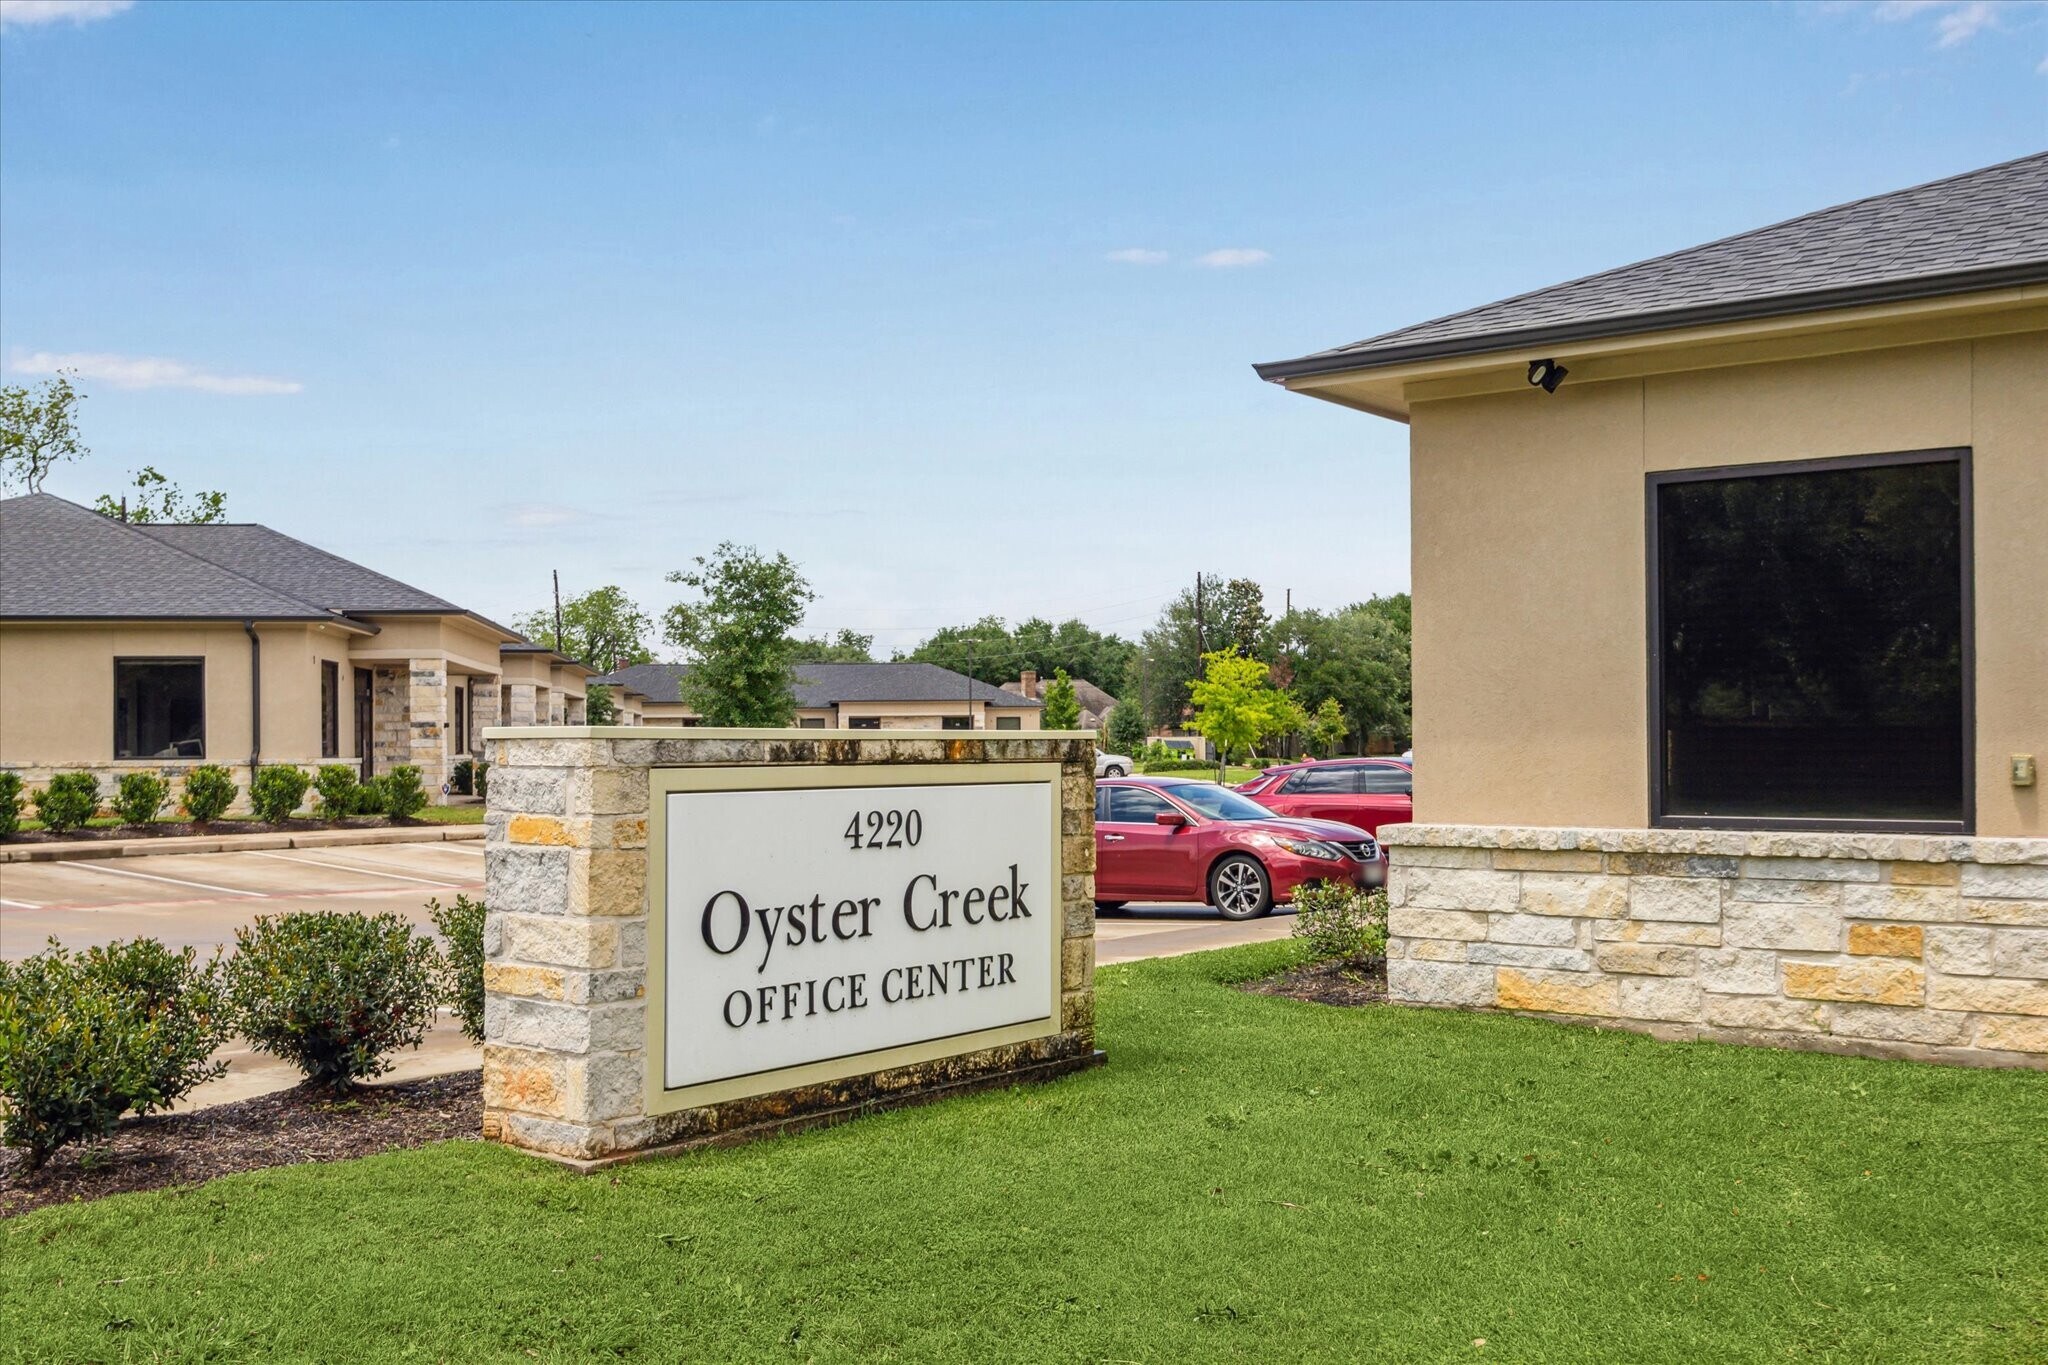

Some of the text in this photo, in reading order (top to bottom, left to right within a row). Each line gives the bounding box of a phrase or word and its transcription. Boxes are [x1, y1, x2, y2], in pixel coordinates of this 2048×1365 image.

[844, 809, 923, 849] 4220
[701, 863, 1033, 973] Oyster Creek
[723, 953, 1017, 1029] OFFICE CENTER
